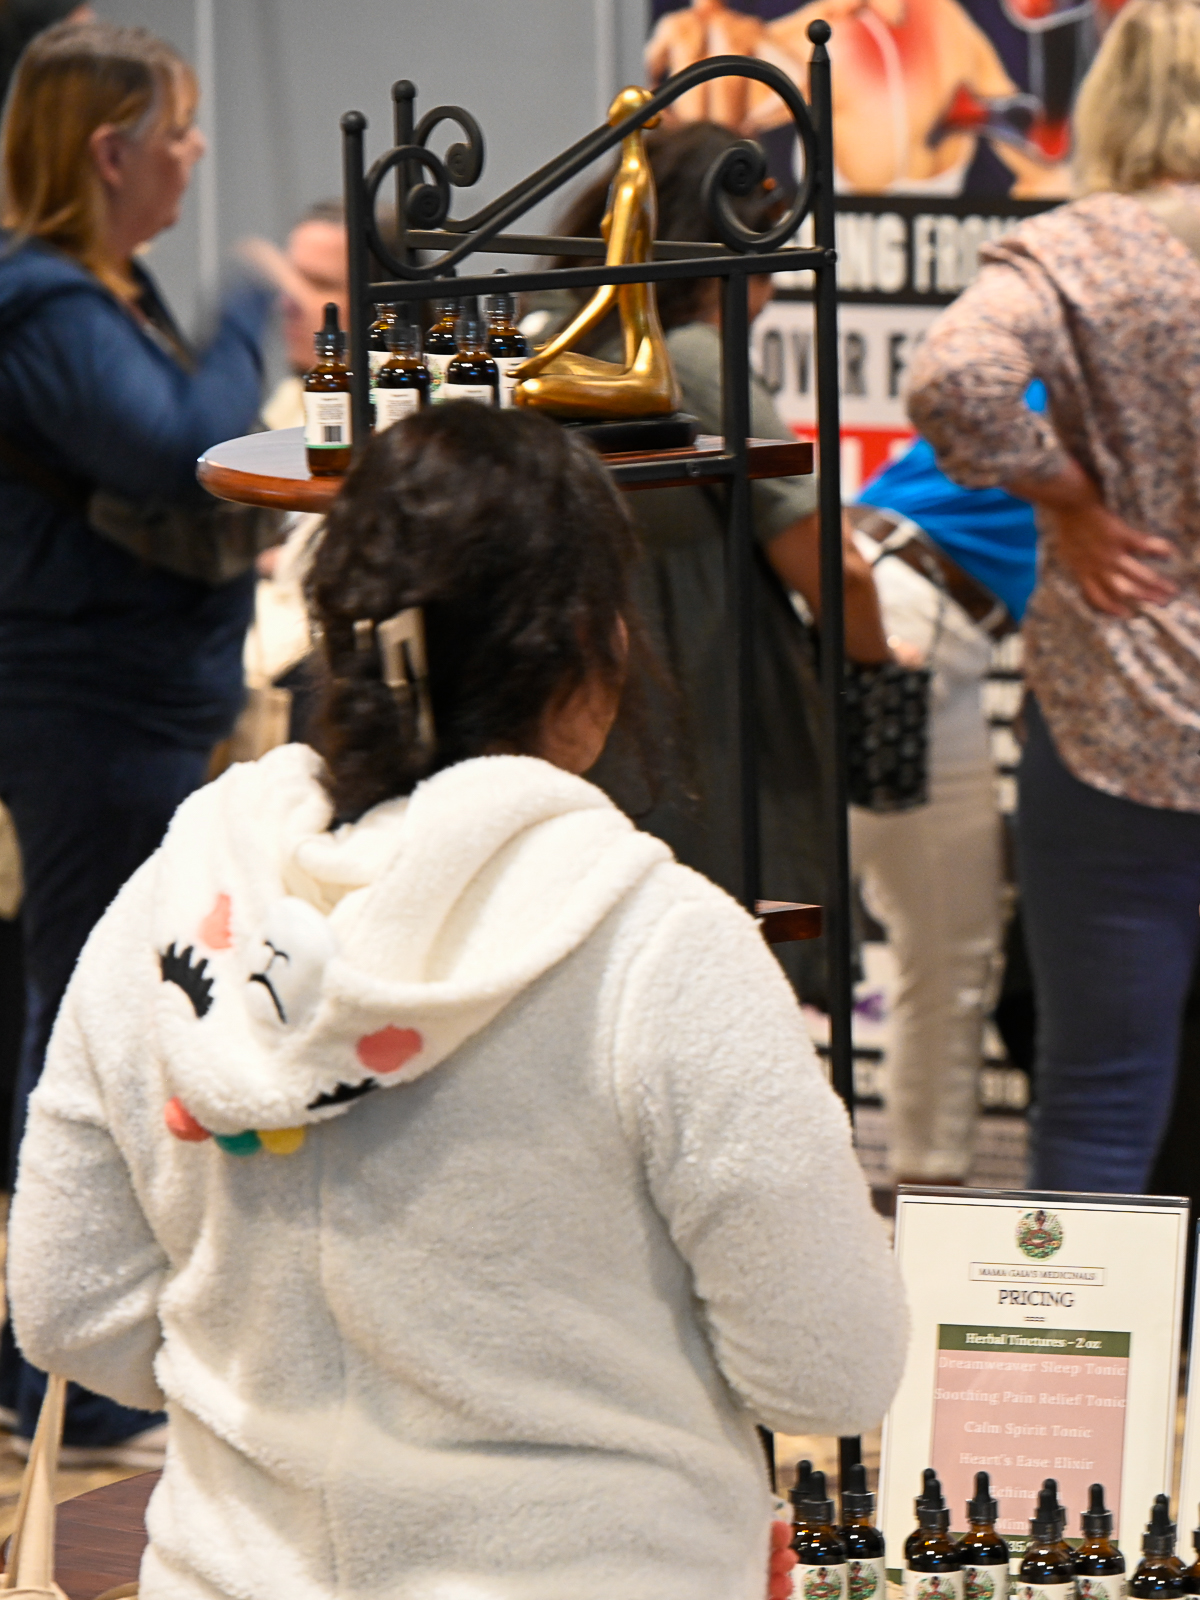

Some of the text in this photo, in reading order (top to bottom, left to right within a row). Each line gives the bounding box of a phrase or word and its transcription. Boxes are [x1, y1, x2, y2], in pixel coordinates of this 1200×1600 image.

[763, 330, 868, 398] OVR
[979, 1268, 1006, 1278] MAMA
[1040, 1270, 1096, 1281] MEDICINALS
[998, 1289, 1075, 1307] PRICING
[965, 1333, 1006, 1346] Herbal
[1006, 1334, 1067, 1348] Tinctures
[1075, 1338, 1086, 1349] 2
[938, 1356, 1127, 1376] Dreamweaver Sleep Tonic
[933, 1388, 1126, 1408] Soothing Pain Relief Tonic
[964, 1421, 1092, 1438] Calm Spirit Tonic
[959, 1452, 1095, 1470] Heart's Ease Elixir
